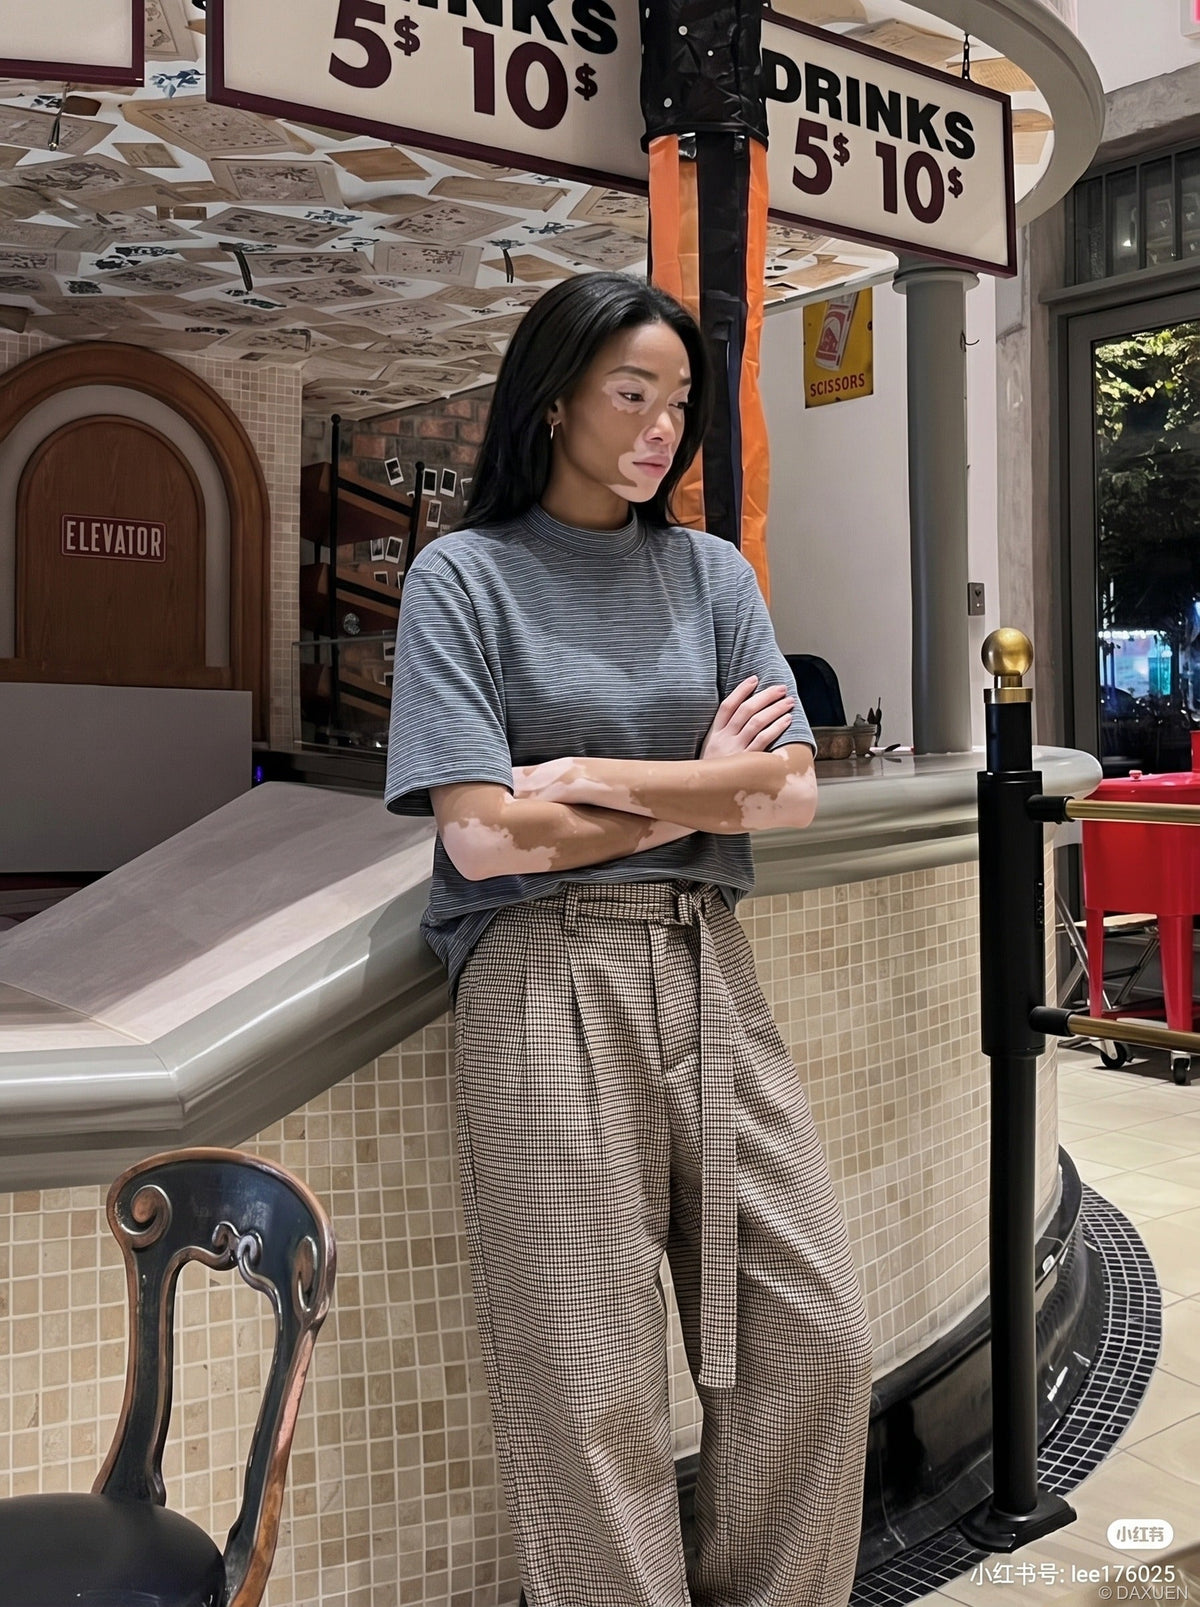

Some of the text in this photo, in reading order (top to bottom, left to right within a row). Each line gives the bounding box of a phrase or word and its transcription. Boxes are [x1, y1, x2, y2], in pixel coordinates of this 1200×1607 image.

[762, 47, 975, 160] DRINKS
[810, 373, 865, 397] SCISSORS
[66, 520, 161, 556] ELEVATOR
